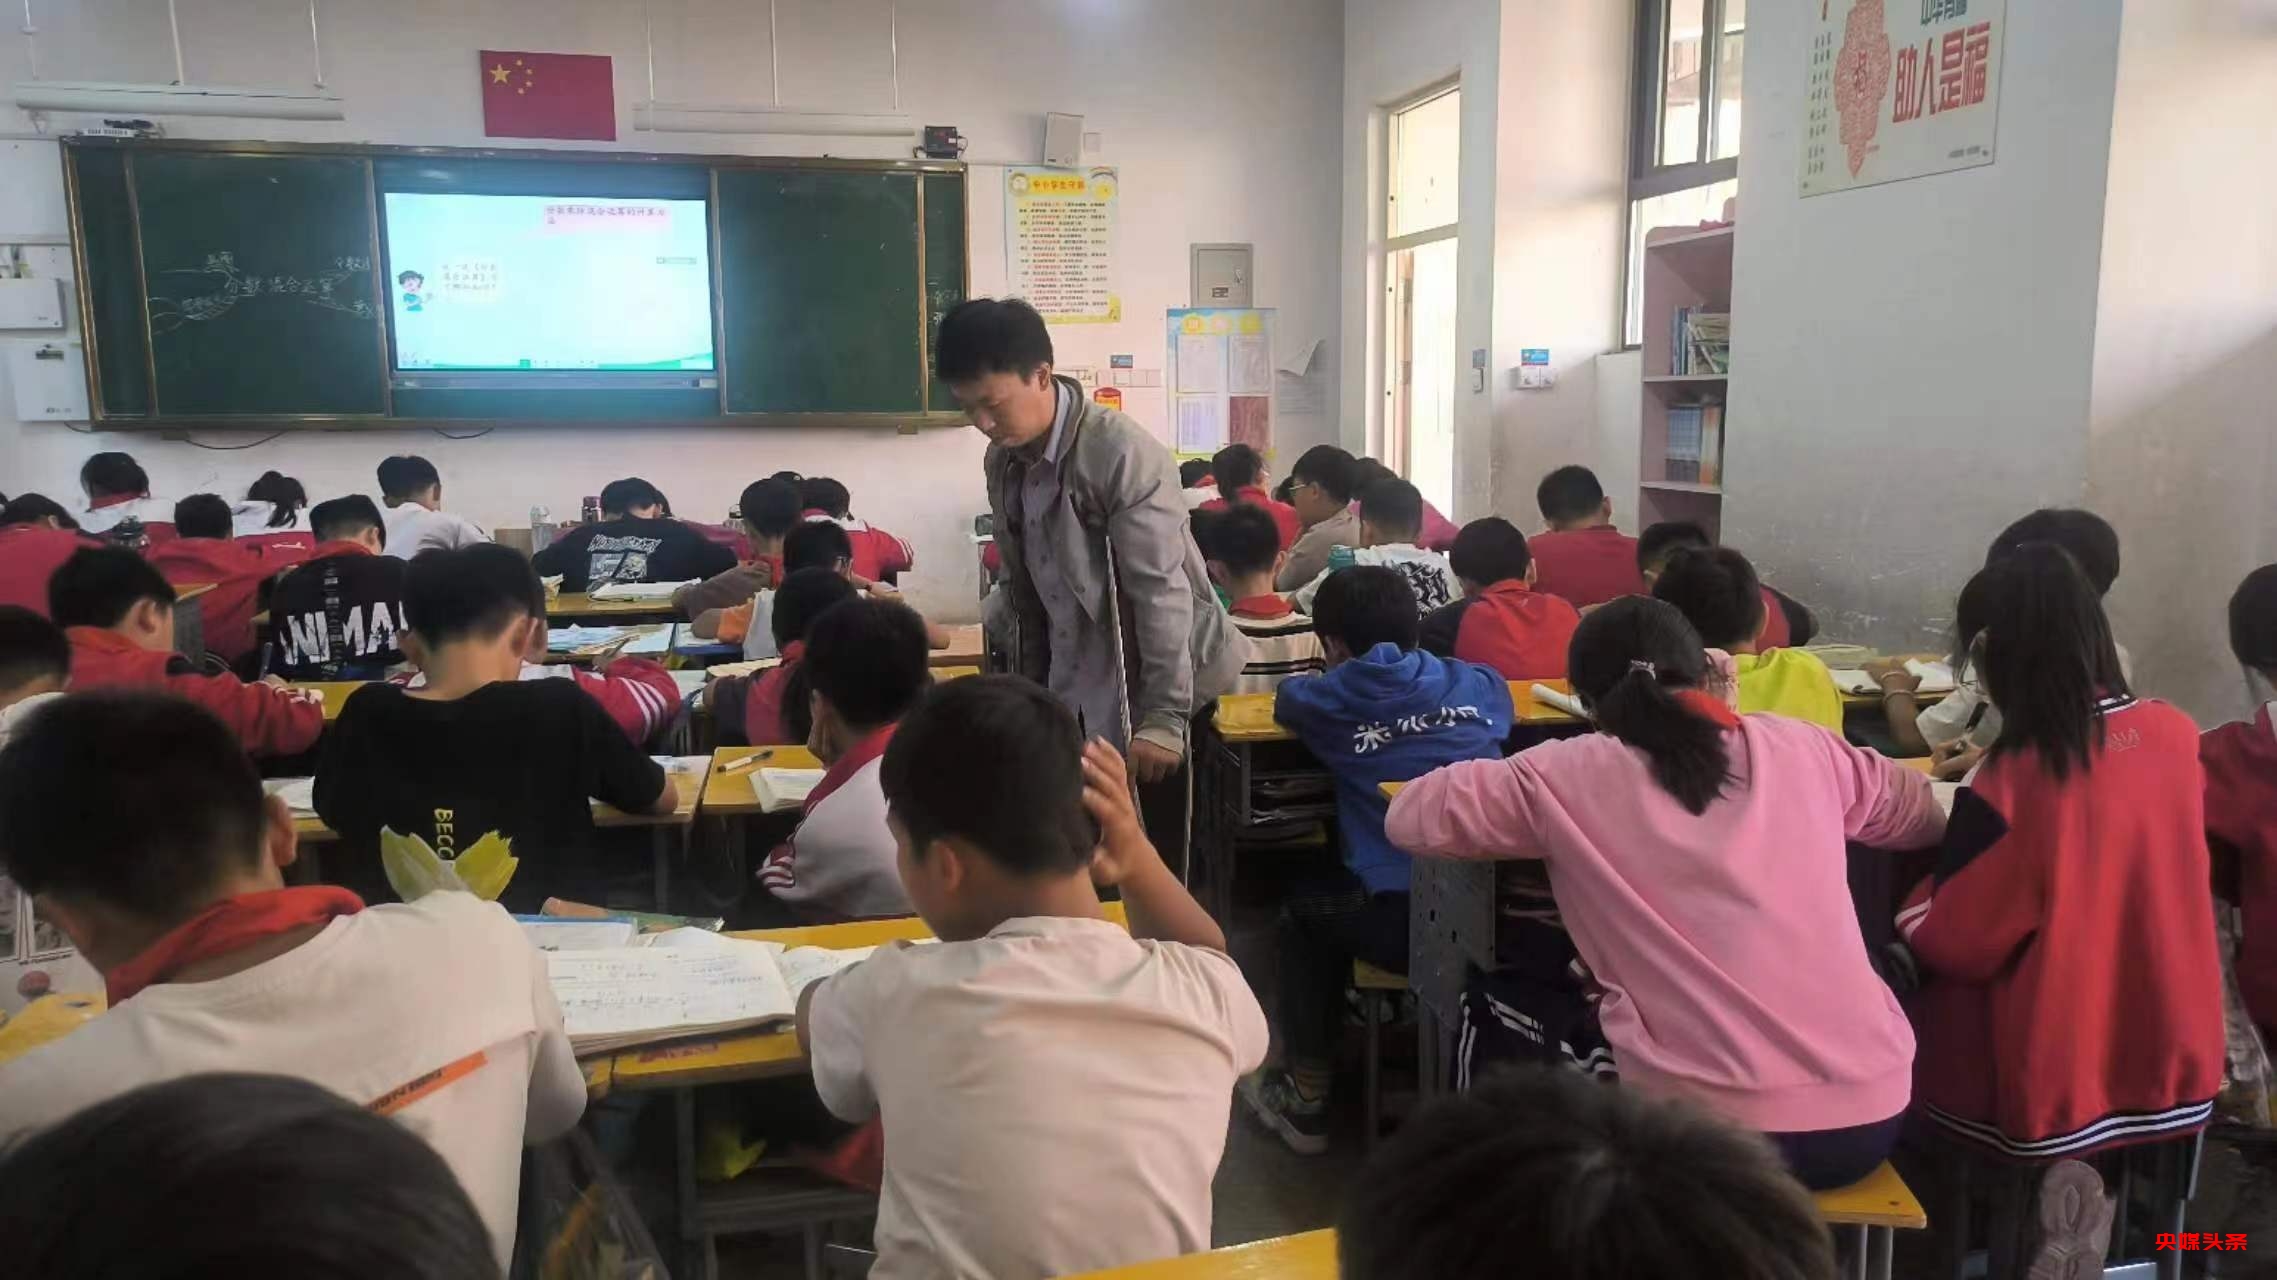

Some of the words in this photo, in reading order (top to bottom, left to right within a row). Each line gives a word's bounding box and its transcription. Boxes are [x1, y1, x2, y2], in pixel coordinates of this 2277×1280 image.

[1892, 22, 1990, 123] 助人是福
[279, 600, 409, 666] NIMA
